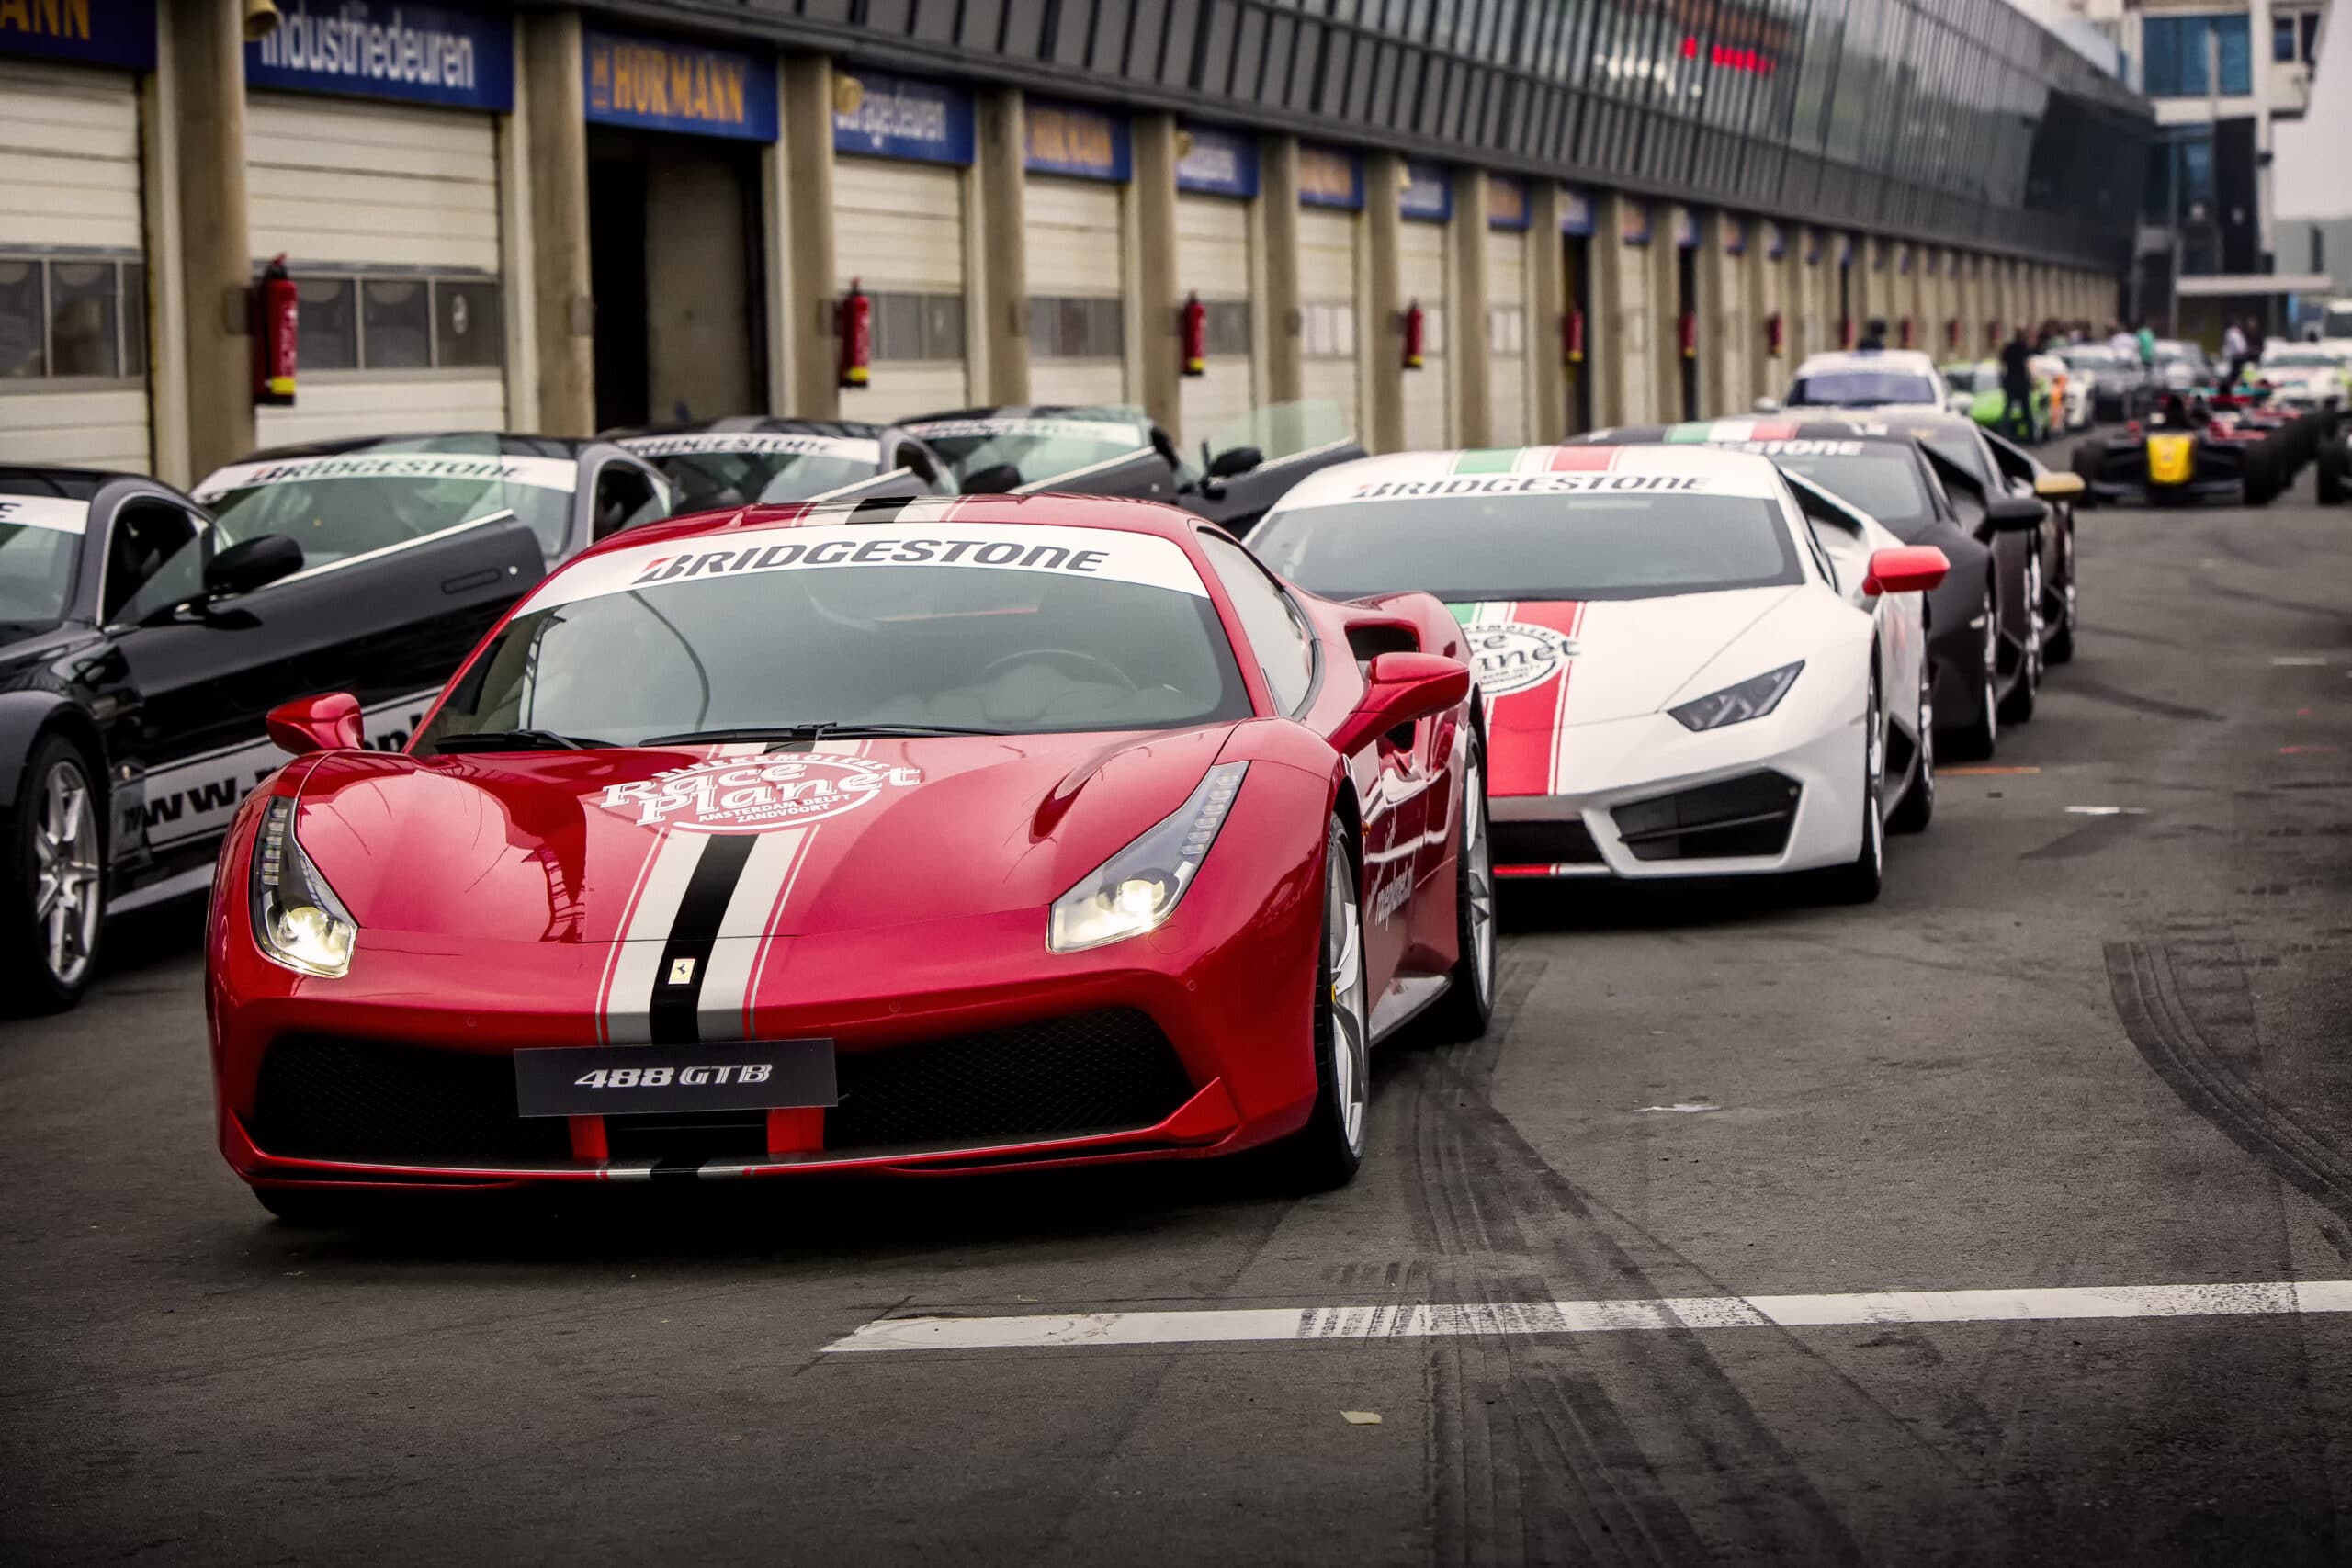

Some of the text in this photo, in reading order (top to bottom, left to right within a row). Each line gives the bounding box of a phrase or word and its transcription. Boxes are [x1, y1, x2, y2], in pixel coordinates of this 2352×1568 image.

[1351, 475, 1712, 499] BRIDGESTONE
[630, 538, 1110, 585] BRIDGESTONE
[652, 753, 891, 779] BLEEKEMOLENS
[600, 762, 809, 808] Race
[636, 767, 922, 827] Planet
[698, 793, 852, 822] AMSTERDAM DELFT
[736, 802, 830, 823] ZANDVOORT
[574, 1063, 774, 1089] 488 GTB
